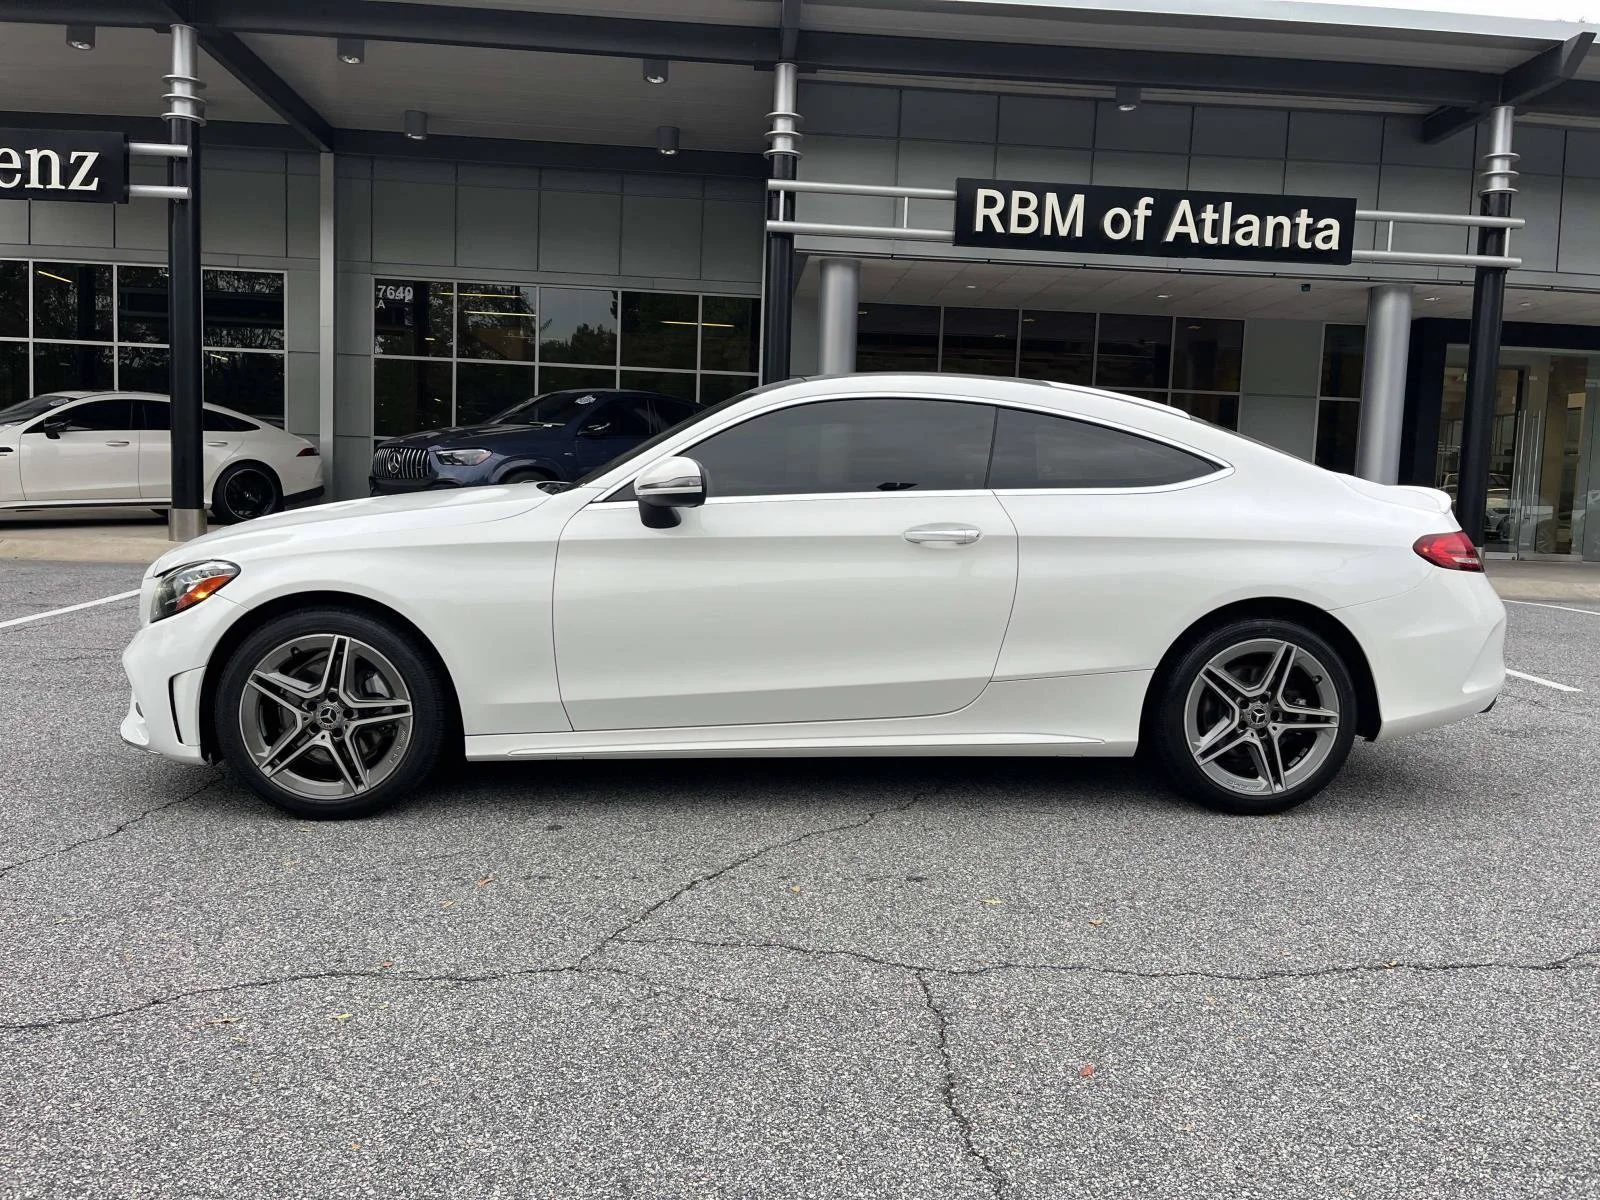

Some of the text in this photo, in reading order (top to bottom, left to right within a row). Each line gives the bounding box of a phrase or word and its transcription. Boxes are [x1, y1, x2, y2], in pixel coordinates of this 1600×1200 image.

[975, 188, 1340, 251] RBM of Atlanta
[377, 285, 413, 300] 7640
[377, 299, 386, 309] A
